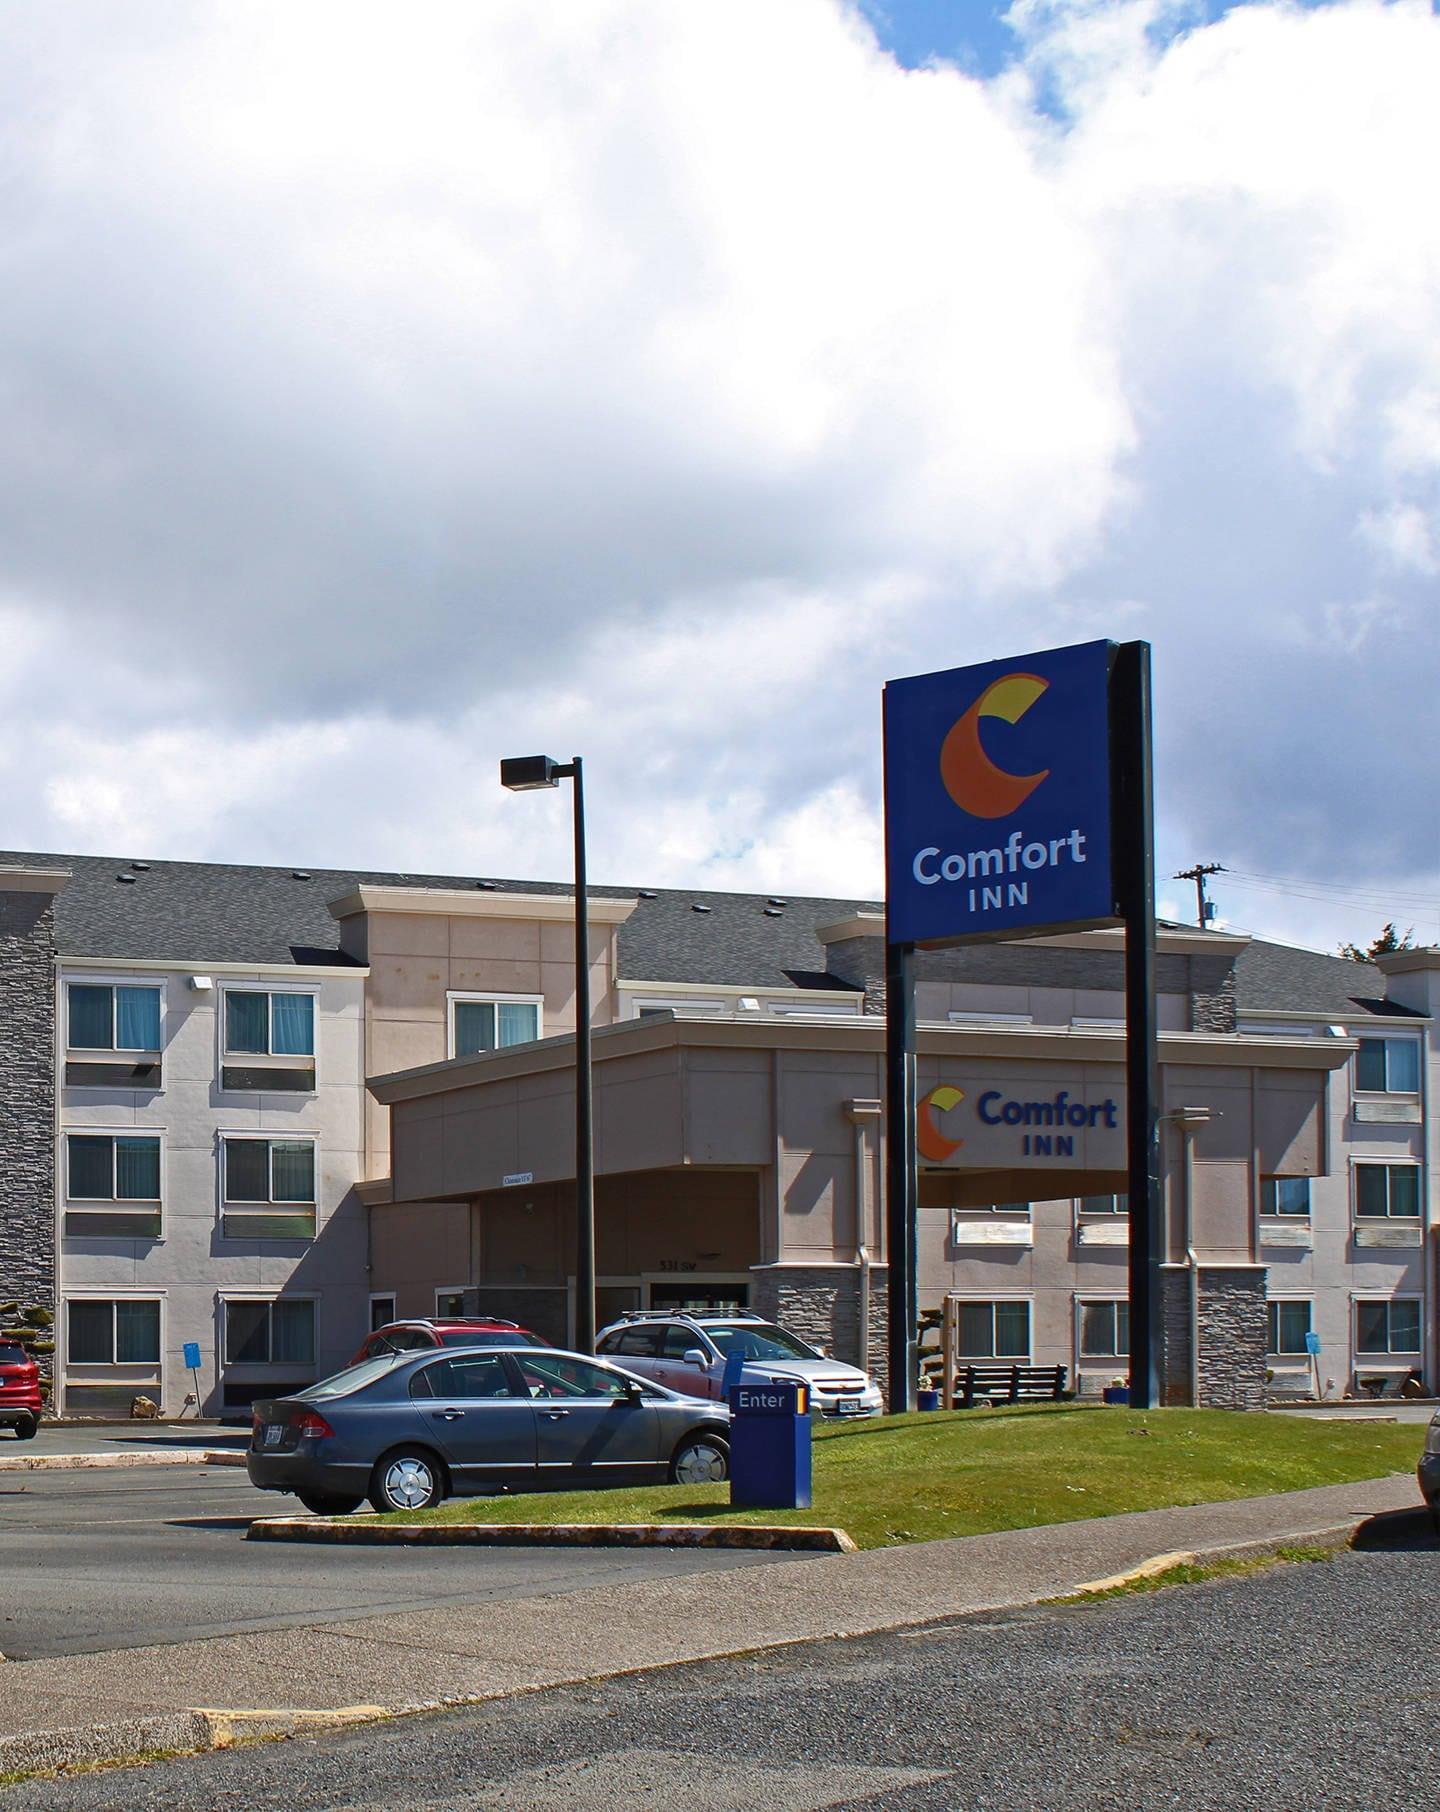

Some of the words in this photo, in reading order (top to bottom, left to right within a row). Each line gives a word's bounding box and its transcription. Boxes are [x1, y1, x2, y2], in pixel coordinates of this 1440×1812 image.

[912, 829, 1087, 885] Comfort
[969, 882, 1028, 912] INN
[977, 1091, 1118, 1128] Comfort
[1023, 1134, 1074, 1157] INN
[739, 1391, 785, 1408] Enter
